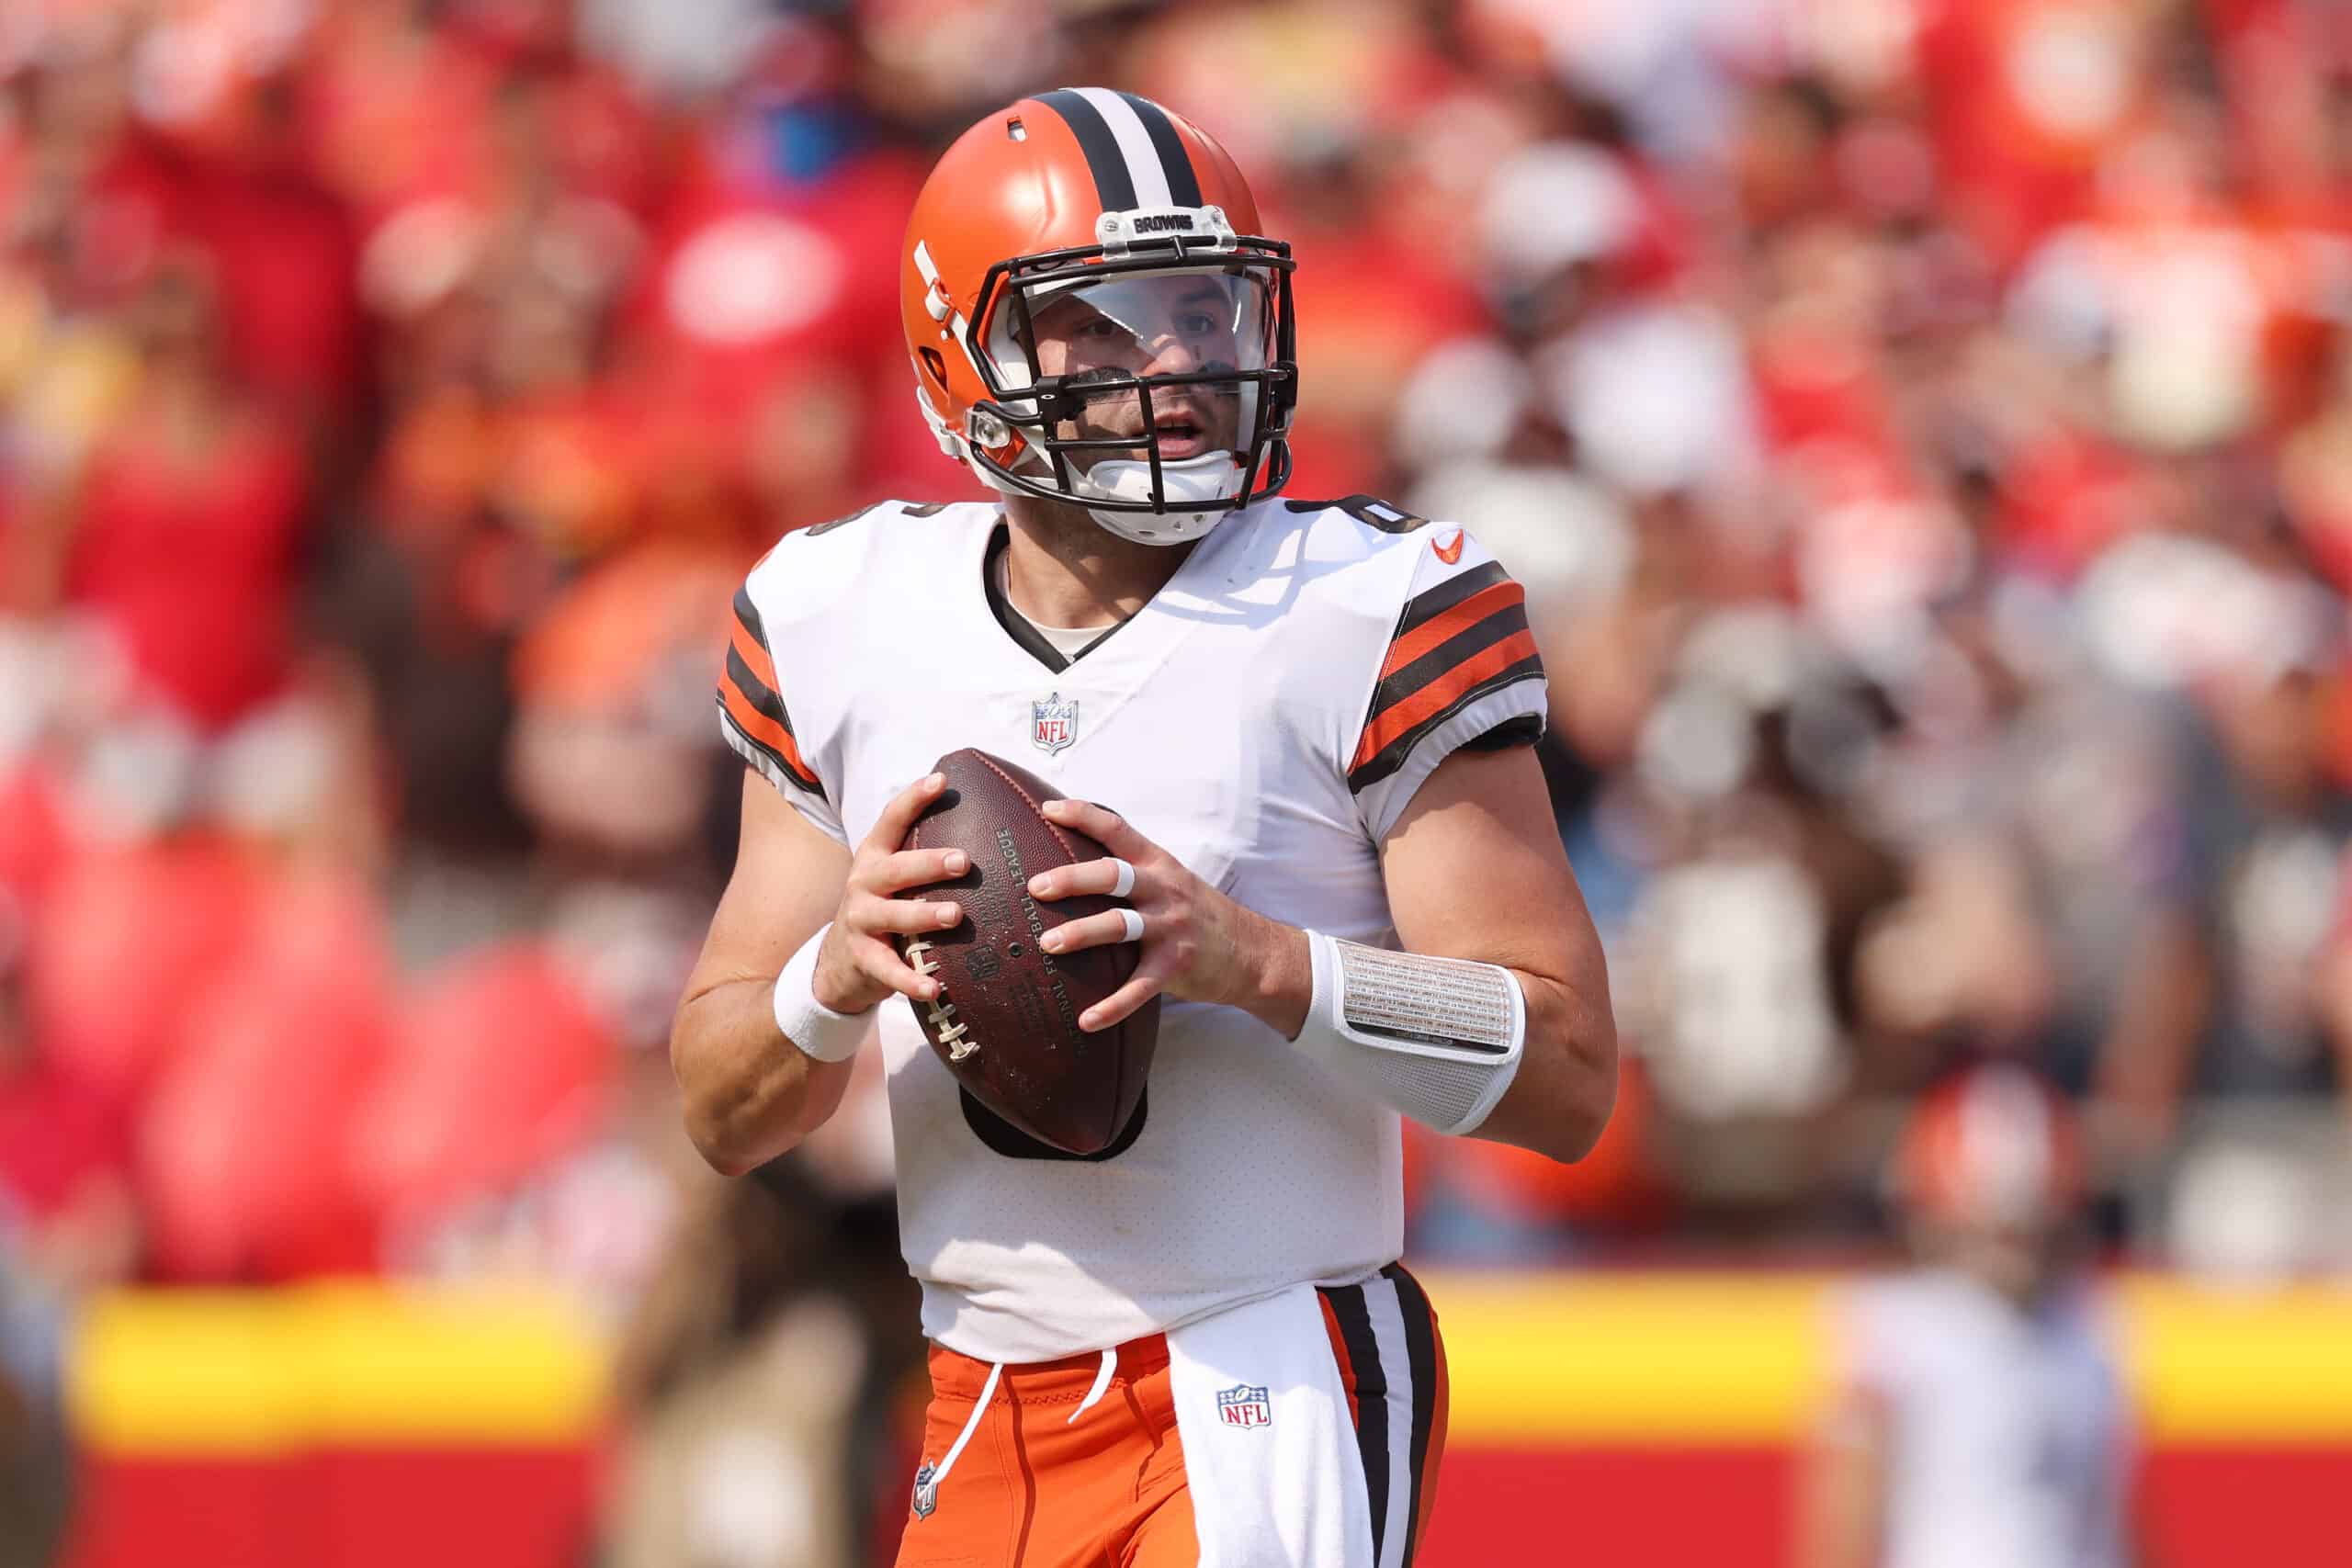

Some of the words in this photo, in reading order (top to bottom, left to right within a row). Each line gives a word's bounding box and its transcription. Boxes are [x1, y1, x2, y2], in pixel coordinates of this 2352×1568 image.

[1133, 214, 1193, 234] BROWNS
[1036, 720, 1068, 743] NFL
[995, 828, 1027, 887] LEAGUE
[1050, 979, 1089, 1055] TIONAL
[1223, 1404, 1268, 1426] NFL
